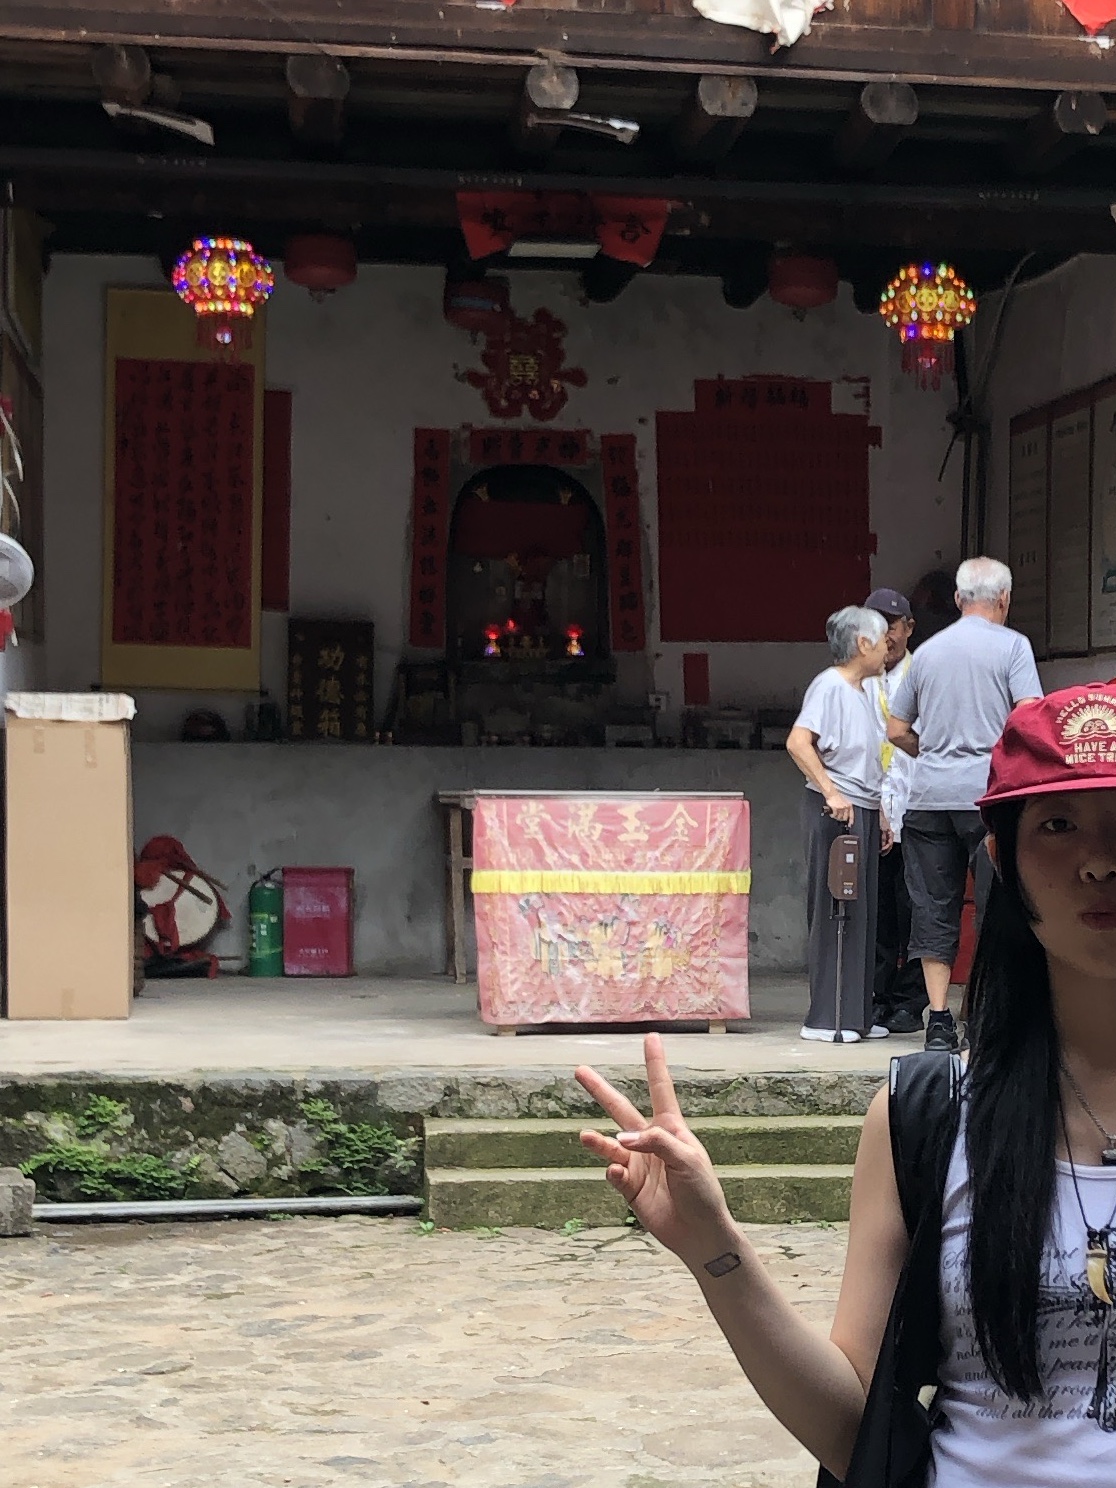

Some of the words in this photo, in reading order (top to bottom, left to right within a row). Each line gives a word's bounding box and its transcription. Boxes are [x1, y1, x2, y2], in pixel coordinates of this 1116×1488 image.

[1055, 695, 1087, 724] HELLO
[1074, 741, 1107, 753] HAVE
[1065, 752, 1096, 765] NICE
